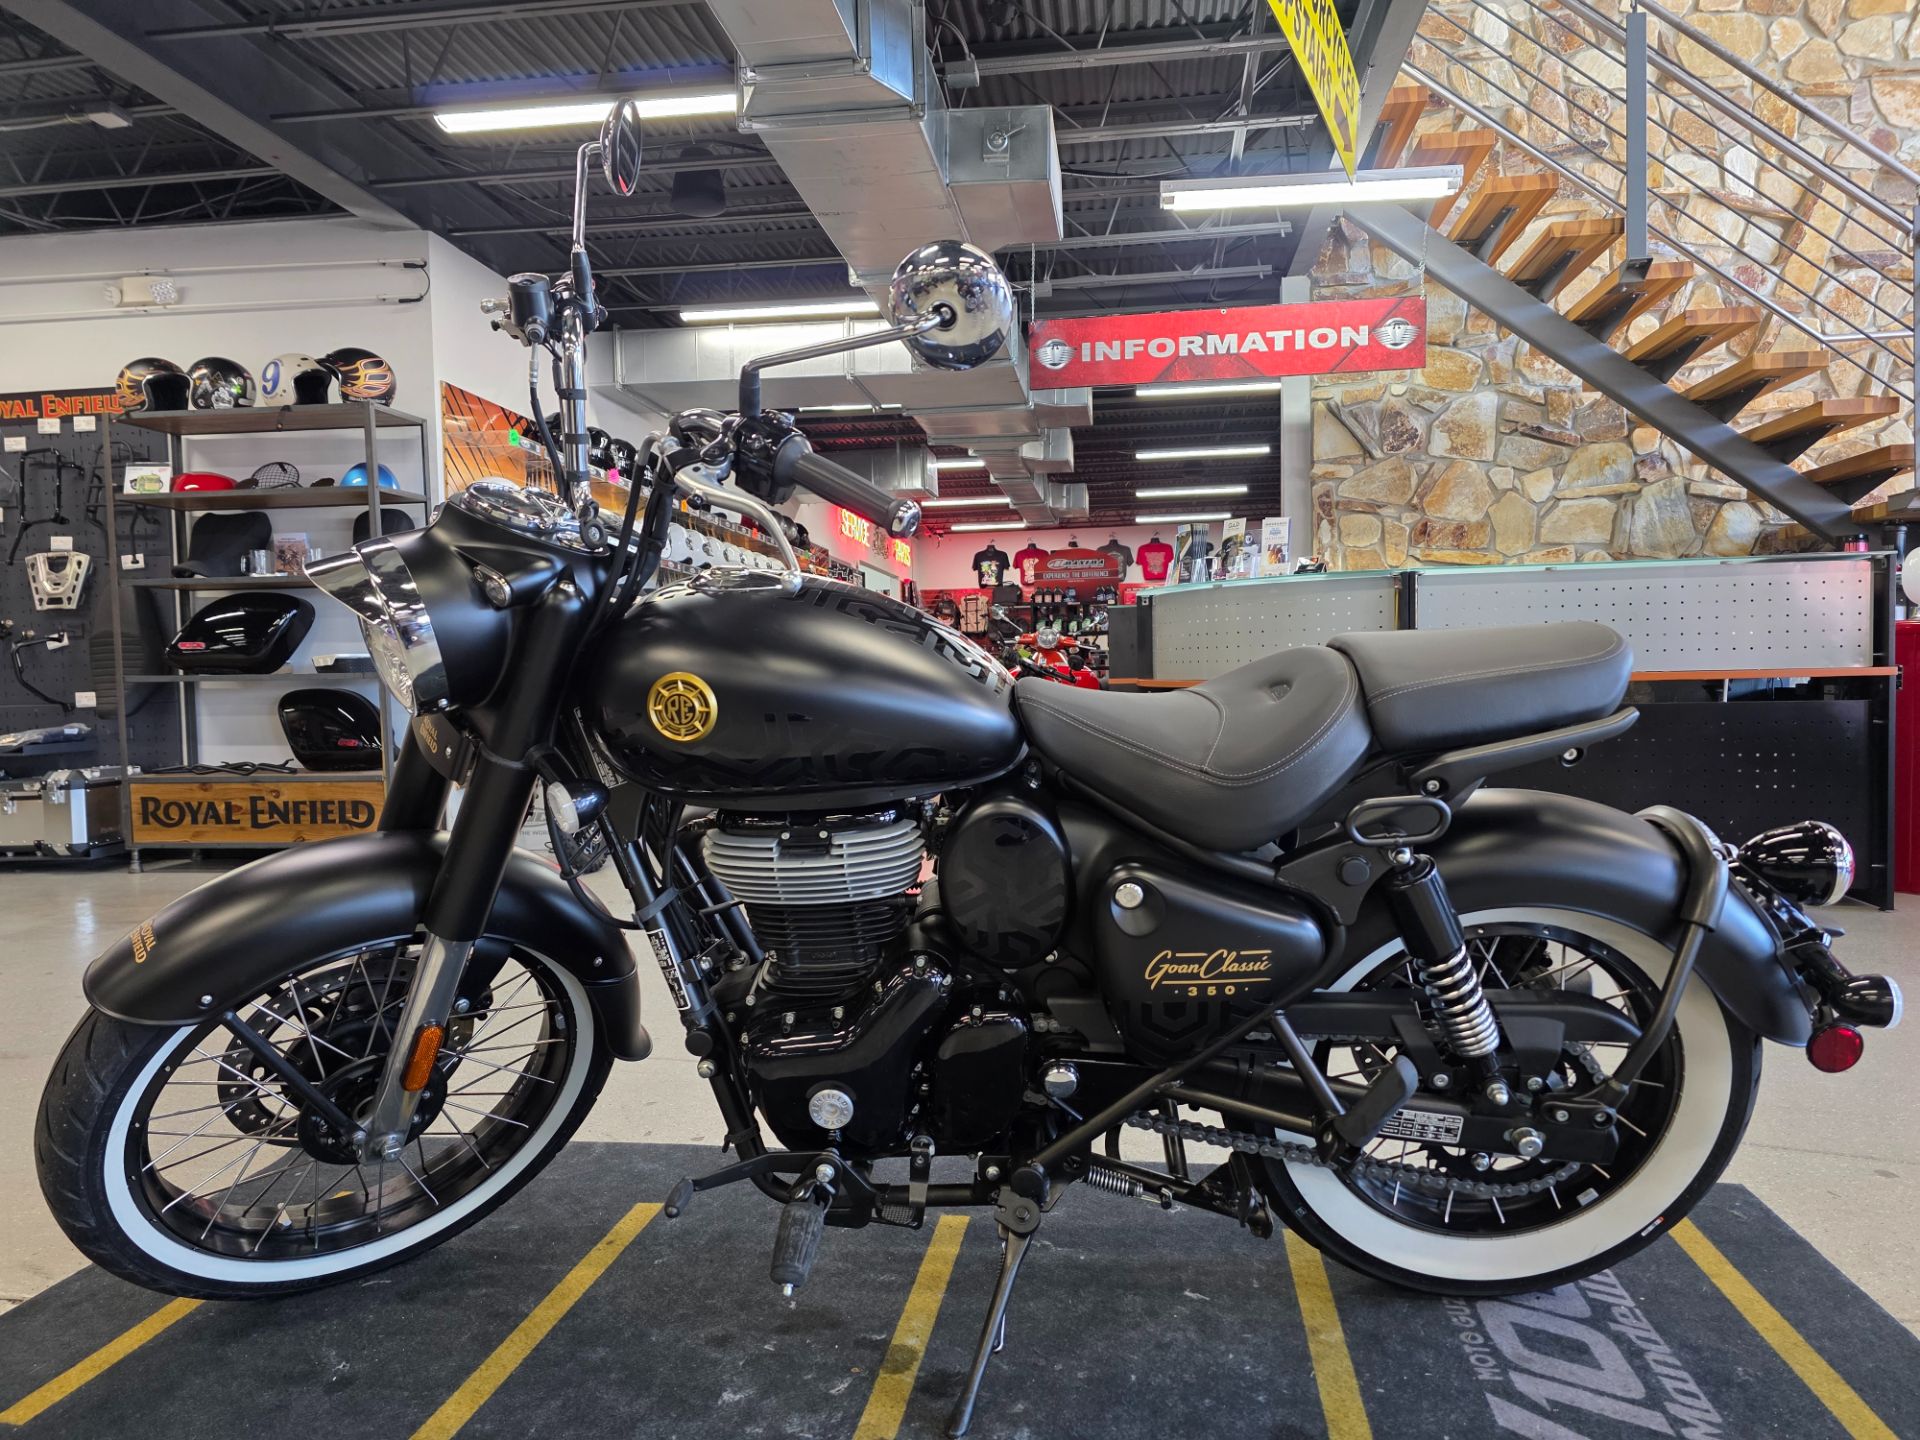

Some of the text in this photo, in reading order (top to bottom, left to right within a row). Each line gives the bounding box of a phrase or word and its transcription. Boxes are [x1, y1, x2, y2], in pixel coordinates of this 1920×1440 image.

[1081, 325, 1369, 362] INFORMATION
[262, 360, 280, 396] 9
[0, 399, 39, 419] YAL
[1043, 571, 1070, 579] EXPERIENCE
[1081, 570, 1109, 578] DIFFERENCE
[140, 796, 376, 829] ROYAL ENFIELD
[1145, 949, 1272, 991] Goan Classic
[1458, 1330, 1504, 1381] MOTO
